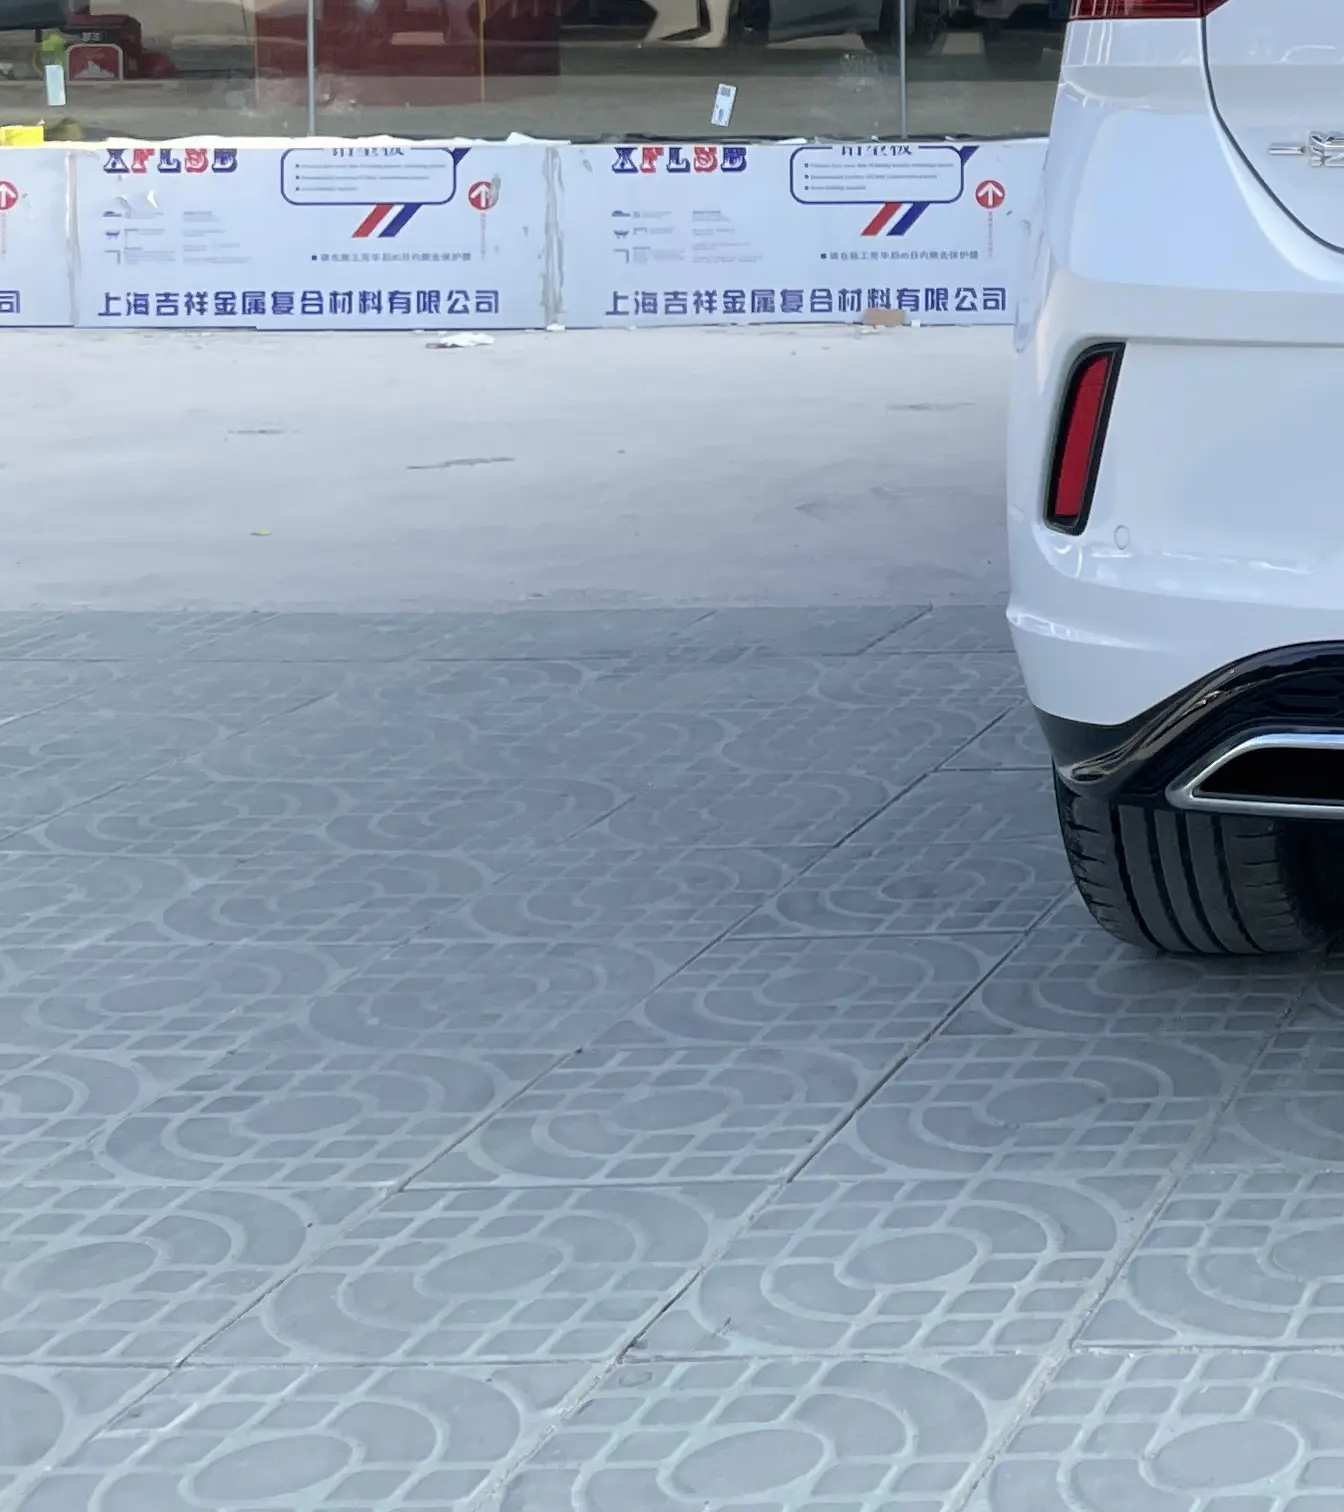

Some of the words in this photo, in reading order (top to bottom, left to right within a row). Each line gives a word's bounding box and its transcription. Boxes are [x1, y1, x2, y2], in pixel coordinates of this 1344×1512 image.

[97, 290, 499, 317] 上海吉祥金属复合材料有限公司
